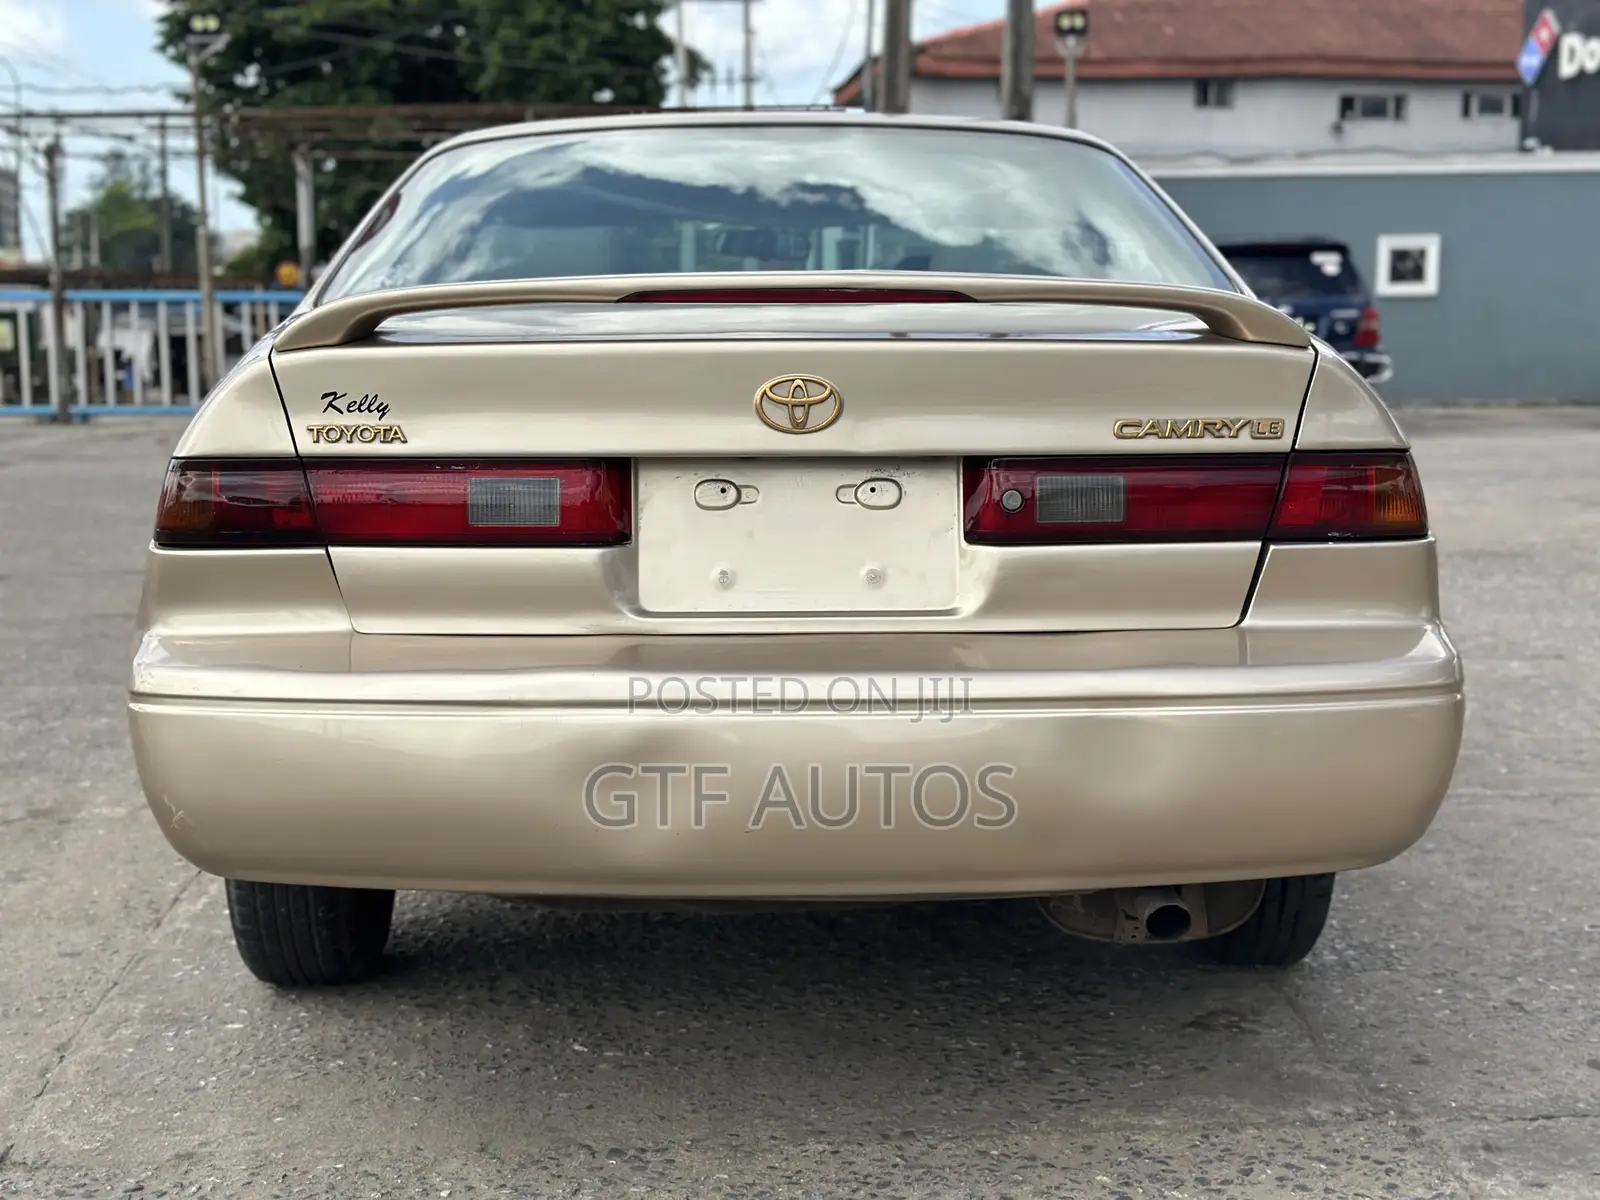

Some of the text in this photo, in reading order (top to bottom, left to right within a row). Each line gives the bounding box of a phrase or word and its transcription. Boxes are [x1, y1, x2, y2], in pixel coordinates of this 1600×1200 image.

[320, 391, 391, 421] Kelly
[307, 424, 408, 443] TOYOTA
[1113, 418, 1283, 439] CAMRY LE
